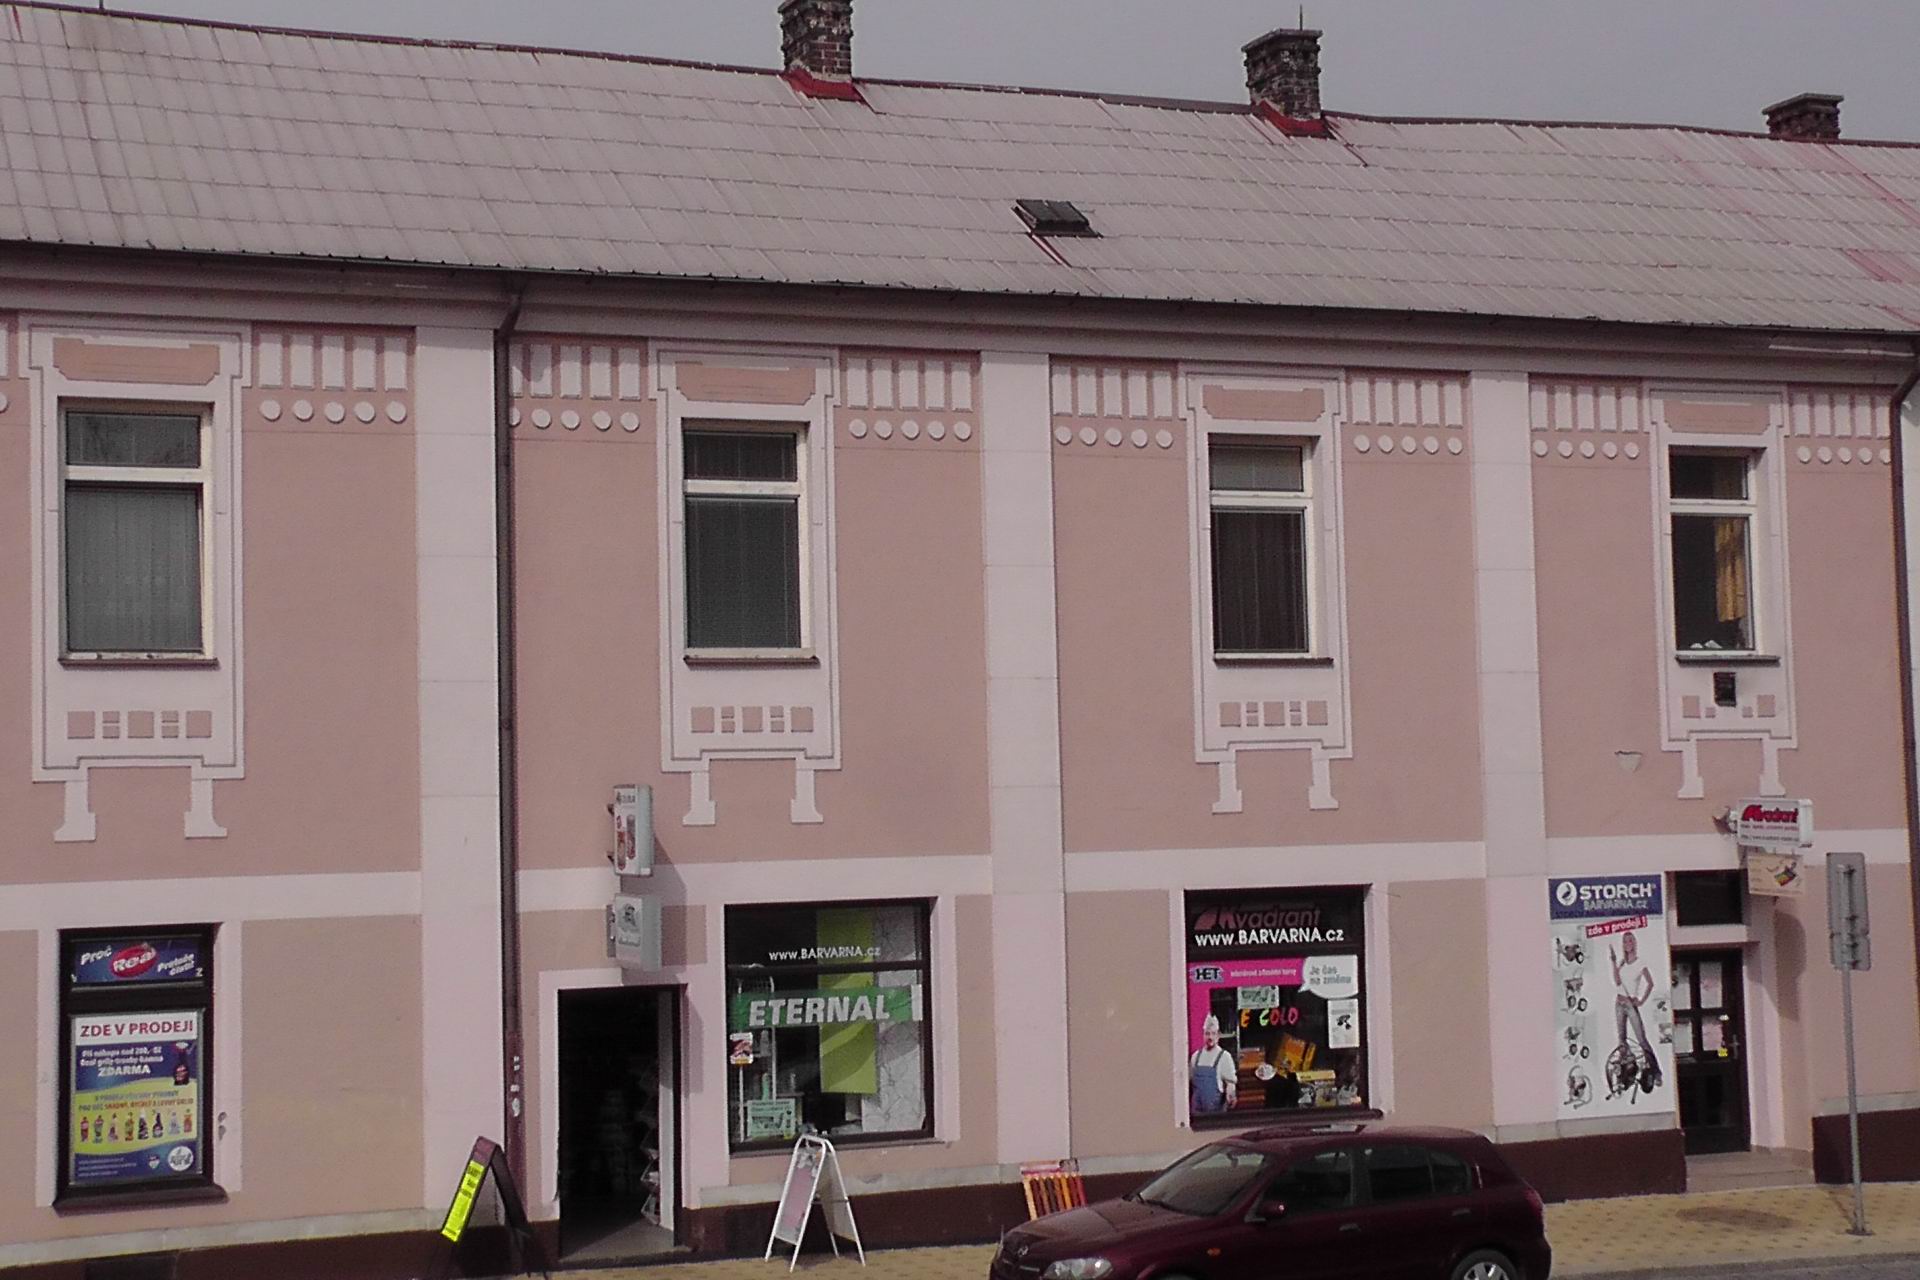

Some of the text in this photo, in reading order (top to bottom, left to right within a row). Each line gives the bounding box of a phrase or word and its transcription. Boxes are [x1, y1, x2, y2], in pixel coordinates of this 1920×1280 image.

[1579, 883, 1652, 900] STORCH
[1194, 927, 1344, 947] www.BARVARNA.cz
[768, 945, 881, 961] www.BARVARNA.cz
[1196, 967, 1220, 980] HET
[749, 995, 890, 1027] ETERNAL
[80, 1024, 112, 1037] ZDE
[114, 1023, 126, 1035] V
[98, 1064, 151, 1077] ZDARMA
